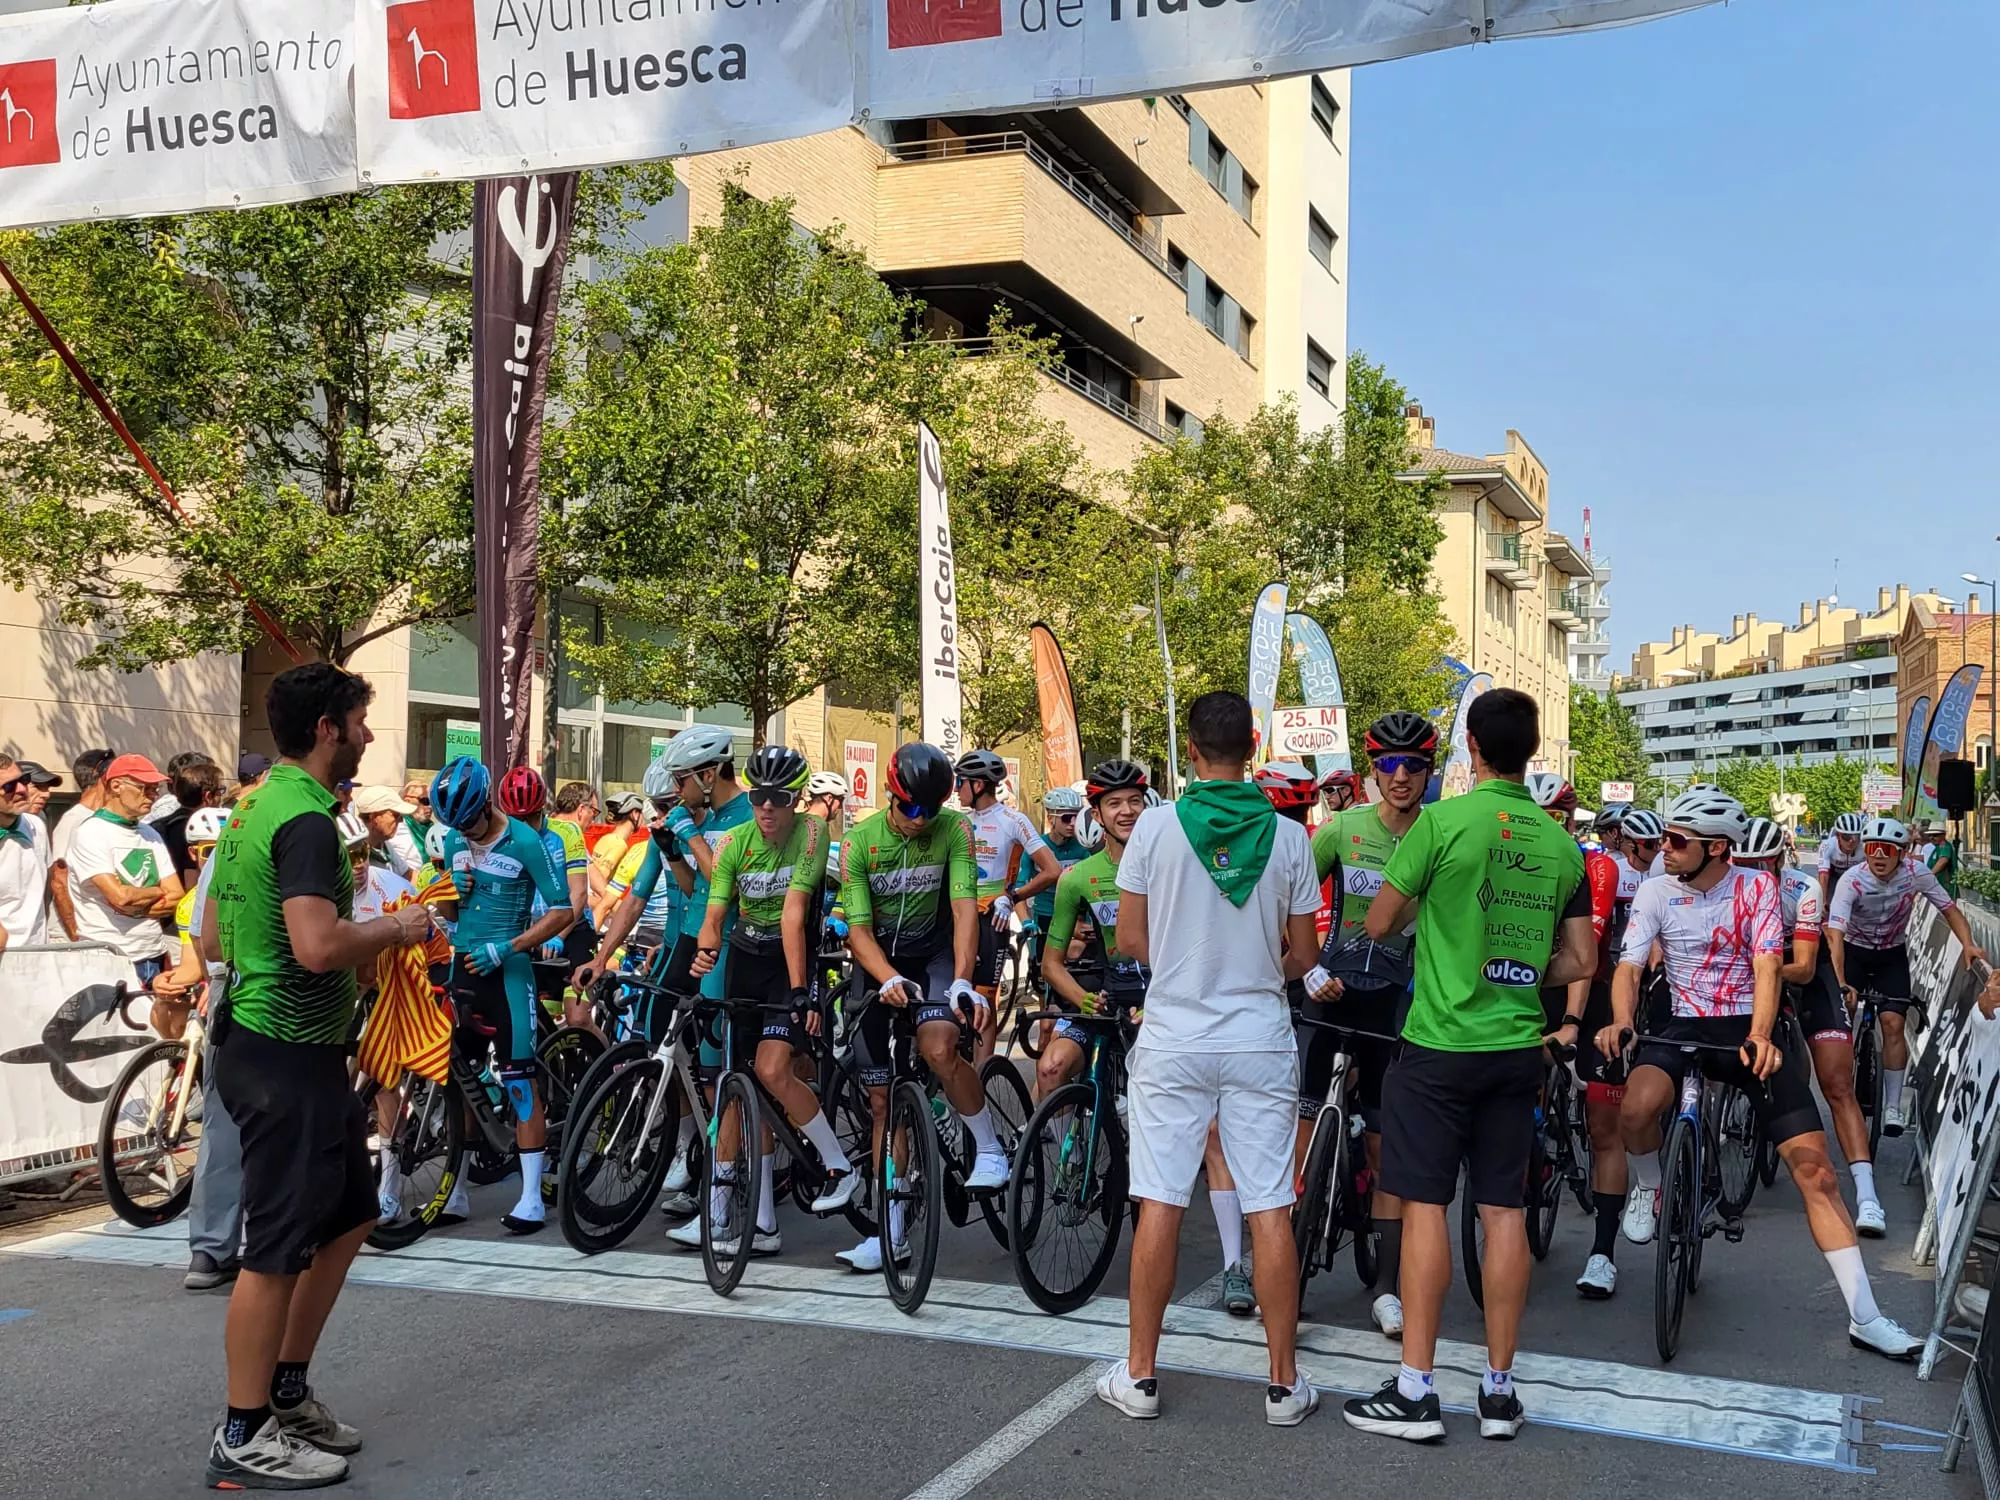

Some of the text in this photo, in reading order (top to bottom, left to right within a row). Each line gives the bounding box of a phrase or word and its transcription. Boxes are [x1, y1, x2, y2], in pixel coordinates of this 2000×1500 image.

[69, 31, 342, 109] Ayuntamiento
[495, 42, 747, 109] de Huesca
[73, 105, 279, 160] de Huesca
[932, 524, 956, 680] iberCaja
[1320, 708, 1338, 726] M
[447, 733, 481, 747] SE ALQUIL
[1291, 732, 1334, 750] ROCAUTO
[1487, 844, 1542, 873] vive
[1492, 897, 1555, 913] AUTOCUATR
[1502, 889, 1556, 904] RENAULT
